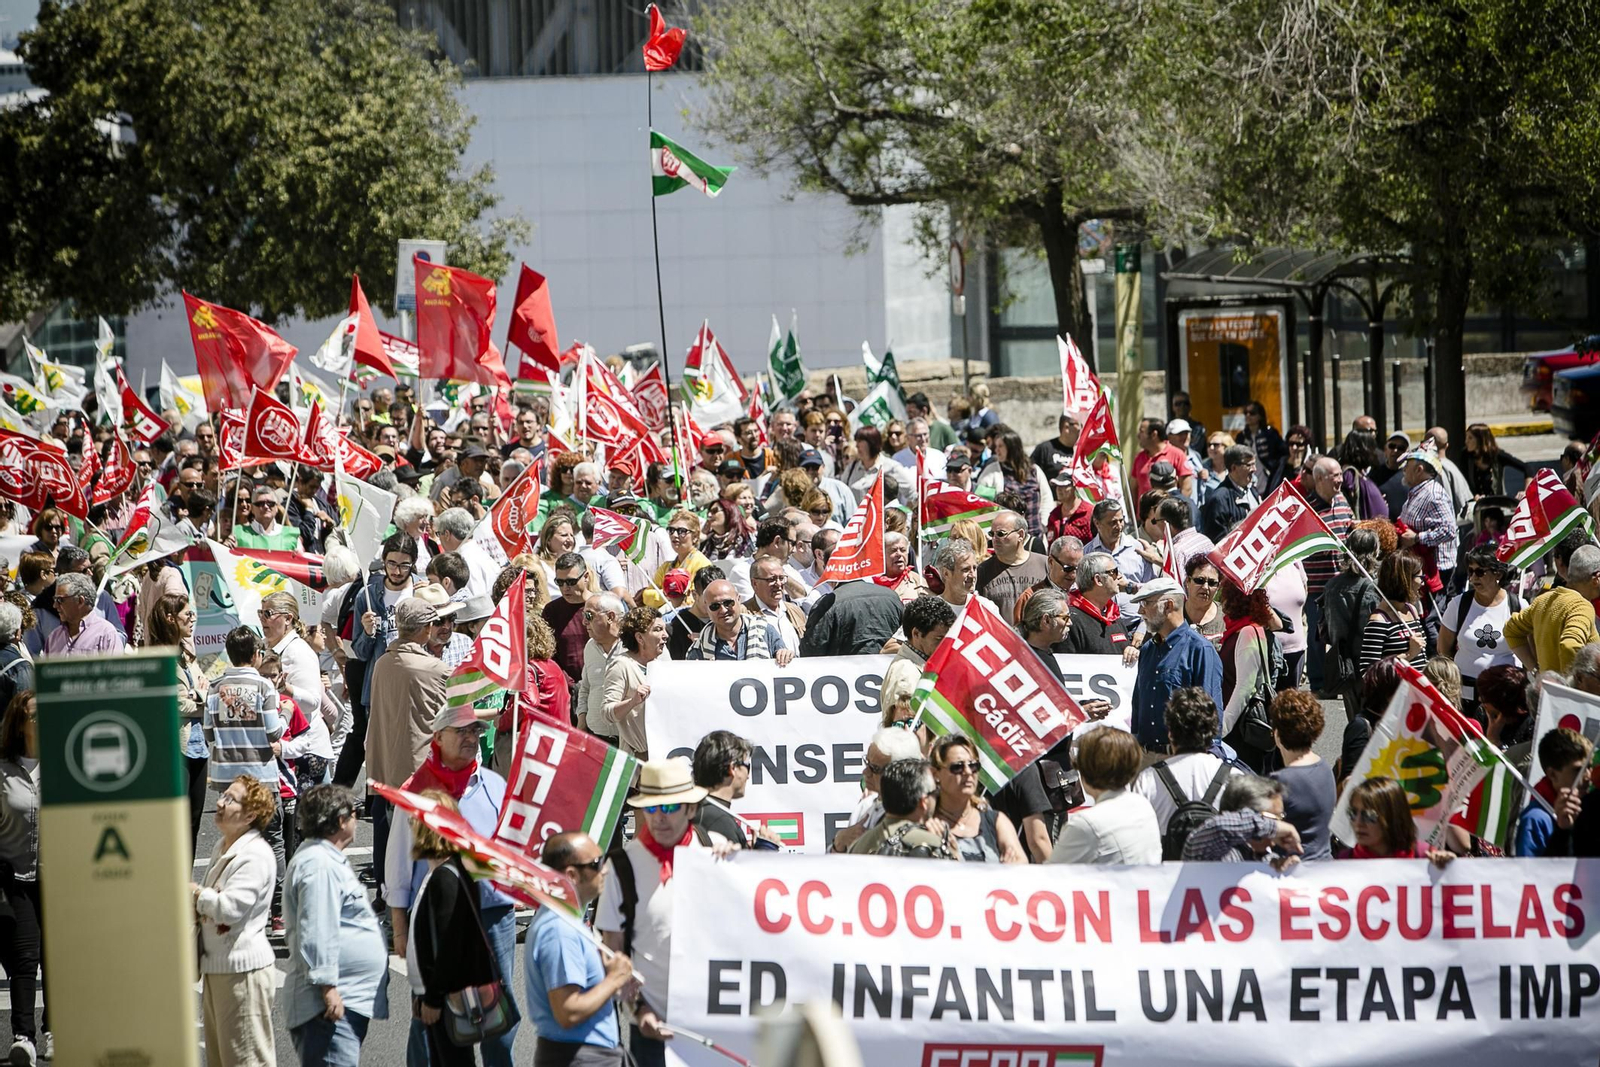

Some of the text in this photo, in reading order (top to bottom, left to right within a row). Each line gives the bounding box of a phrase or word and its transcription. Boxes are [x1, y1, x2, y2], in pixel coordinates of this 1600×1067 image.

[974, 693, 1032, 757] Cádiz
[93, 826, 130, 864] A
[753, 877, 1587, 944] CC.OO. CON LAS ESCUELAS
[832, 962, 1118, 1023] INFANTIL
[1138, 968, 1268, 1024] UNA
[1289, 965, 1478, 1022] ETAPA
